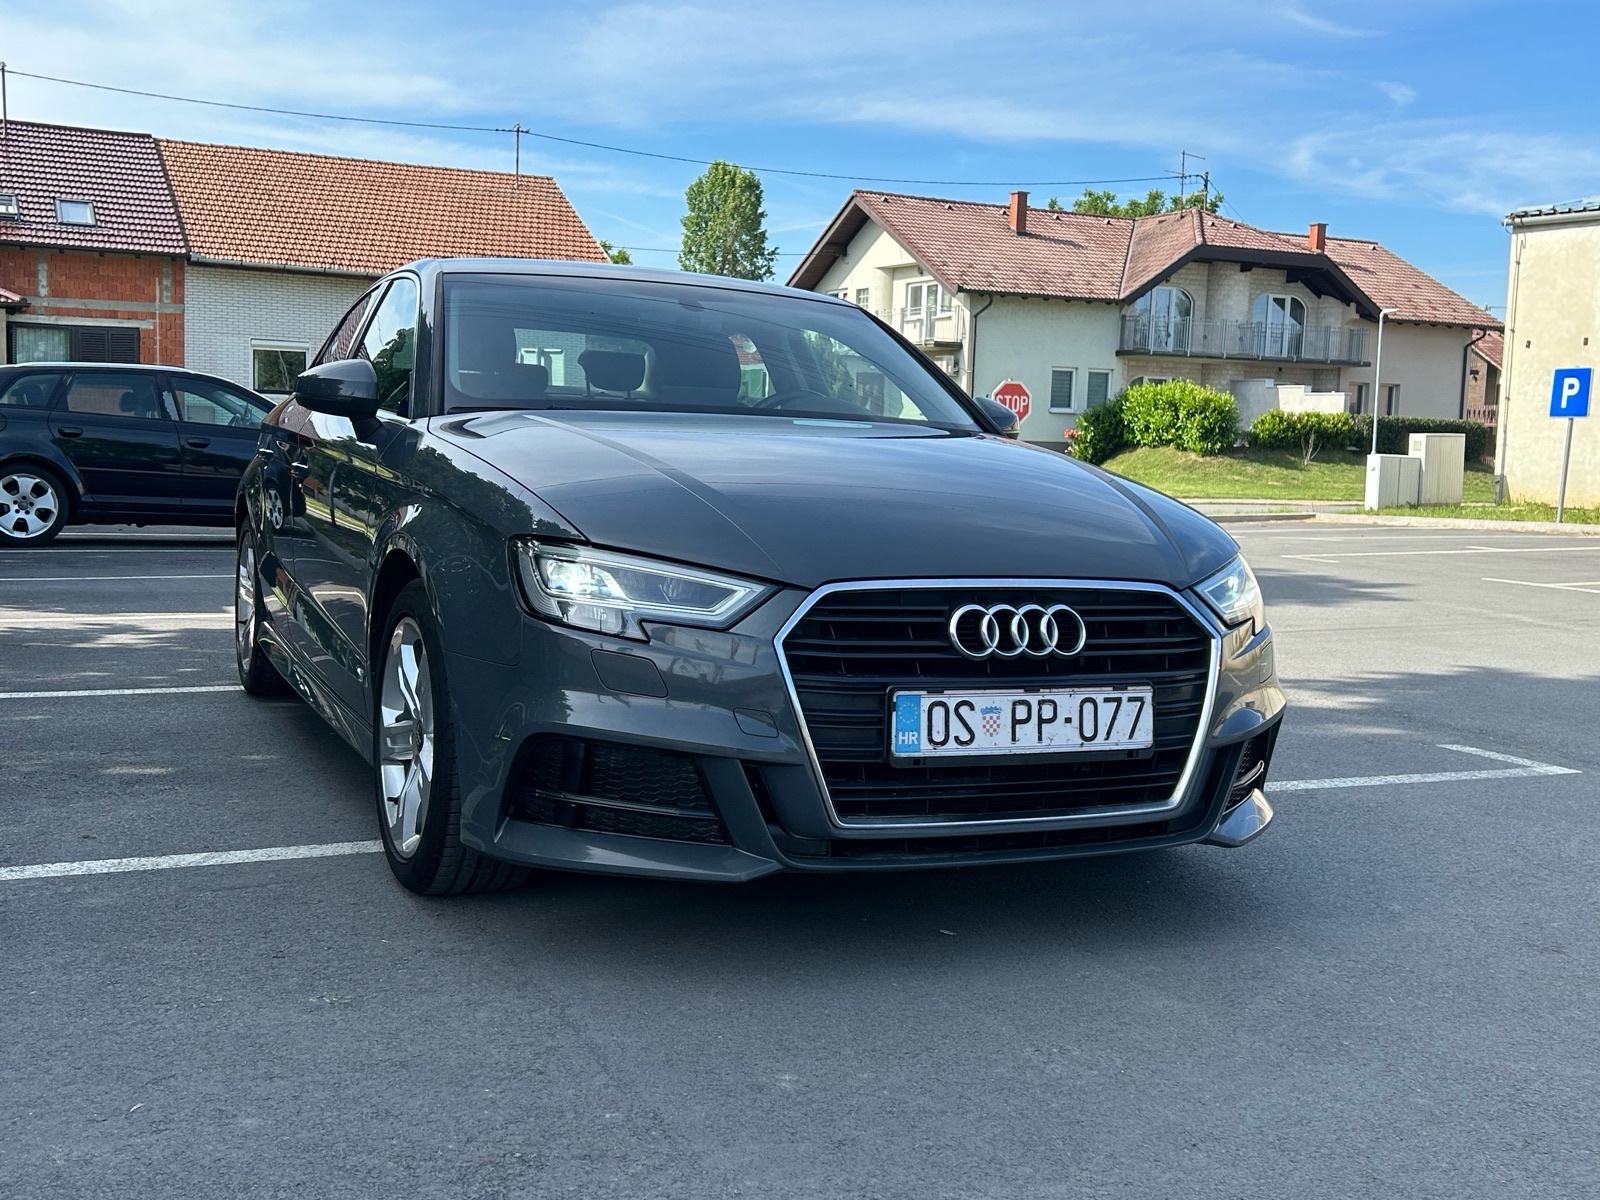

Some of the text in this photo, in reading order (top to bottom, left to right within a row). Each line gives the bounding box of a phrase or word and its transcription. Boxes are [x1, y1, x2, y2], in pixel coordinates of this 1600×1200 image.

[1561, 377, 1580, 409] P
[898, 731, 918, 745] HR
[927, 700, 975, 747] OS
